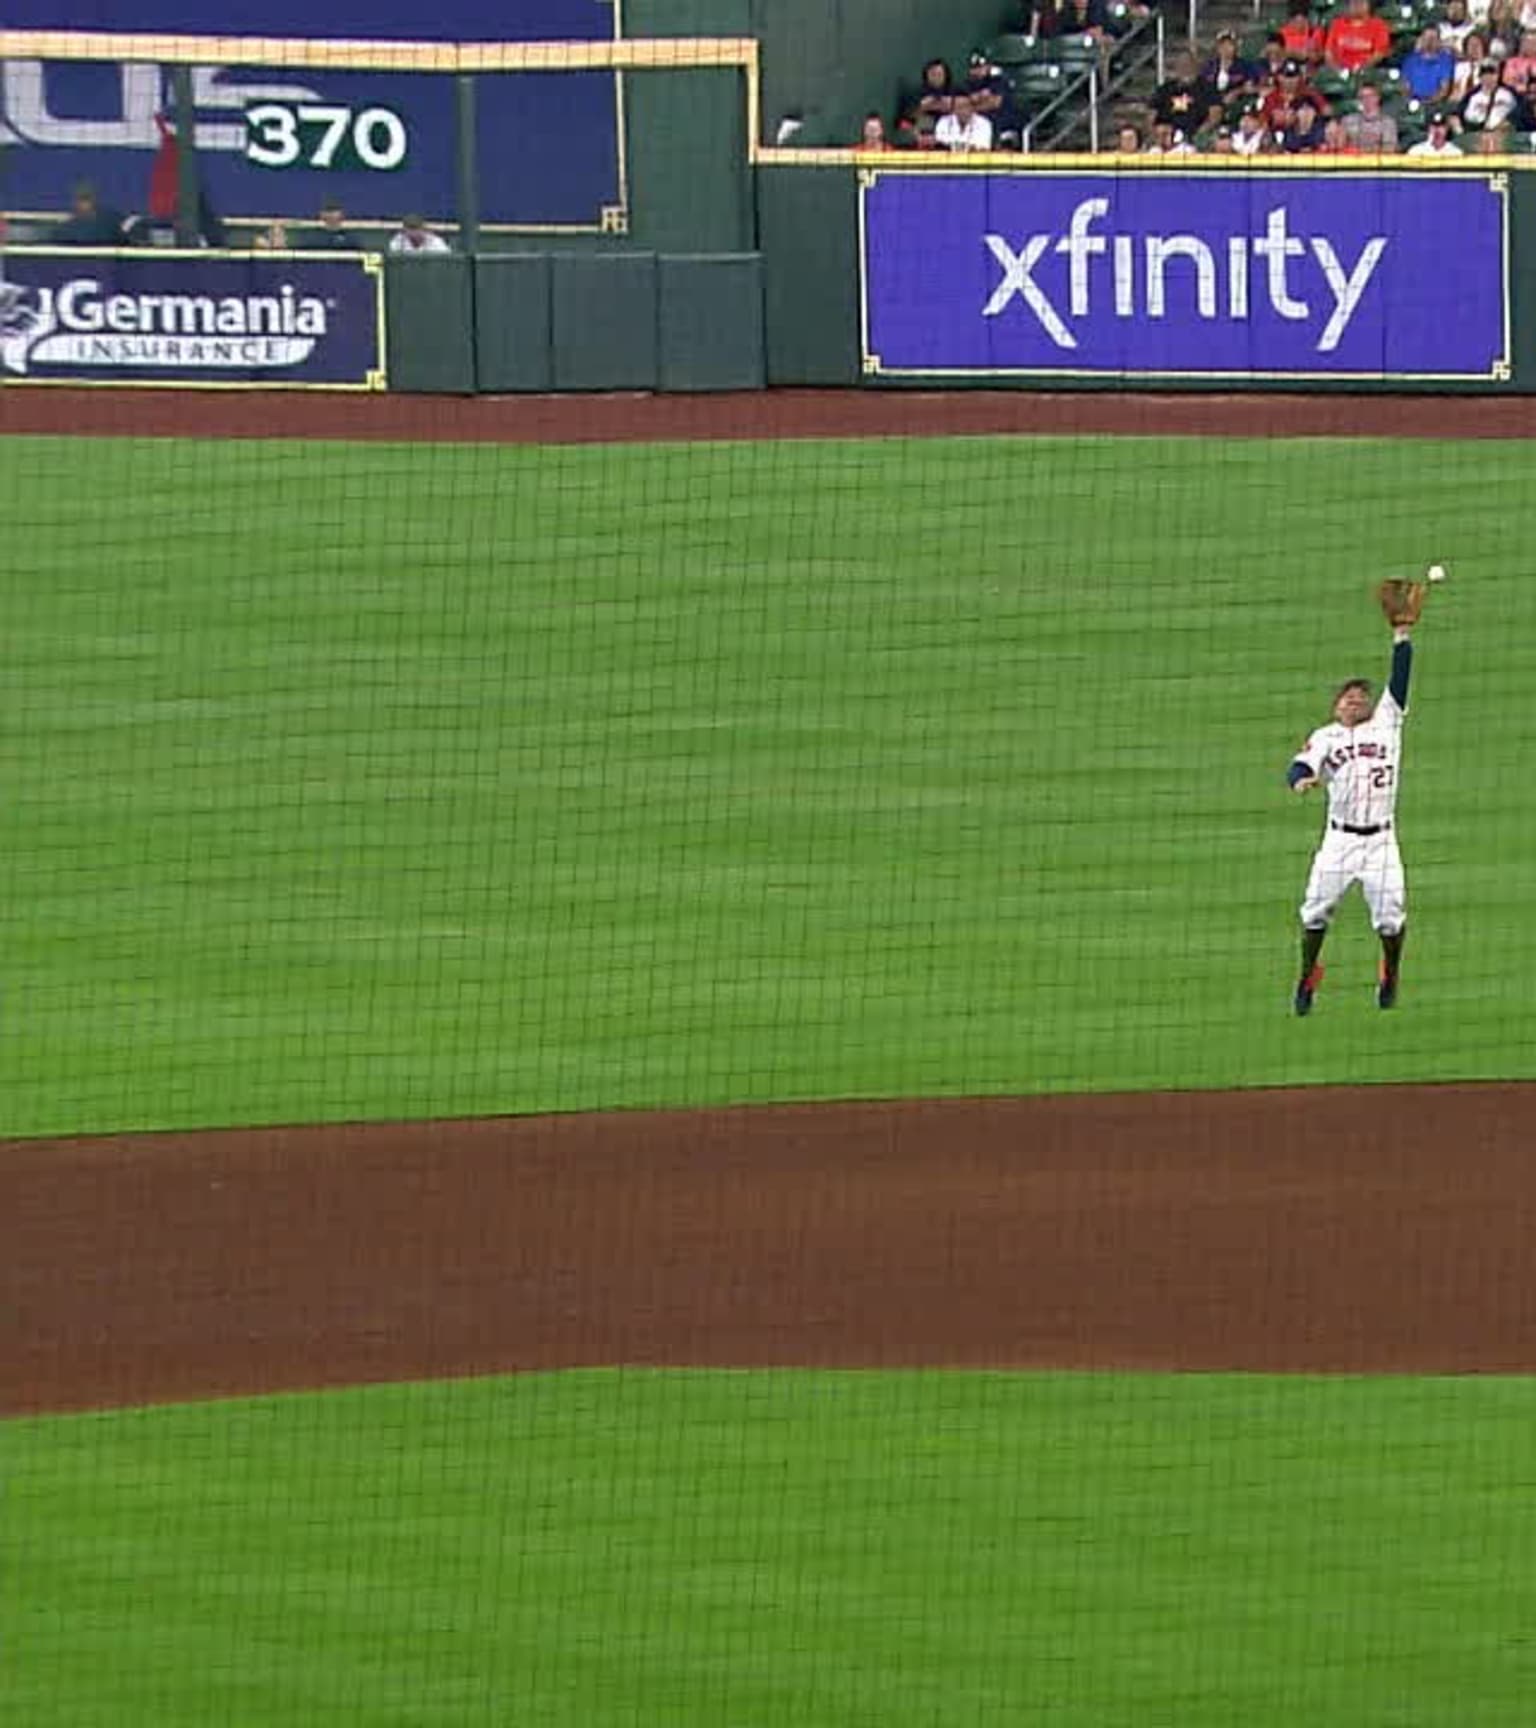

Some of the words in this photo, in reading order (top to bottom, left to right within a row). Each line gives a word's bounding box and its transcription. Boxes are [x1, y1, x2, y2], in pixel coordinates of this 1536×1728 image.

[246, 105, 407, 169] 370
[981, 199, 1387, 350] xfinity
[57, 279, 326, 335] Germania
[76, 338, 276, 362] INSURANCE
